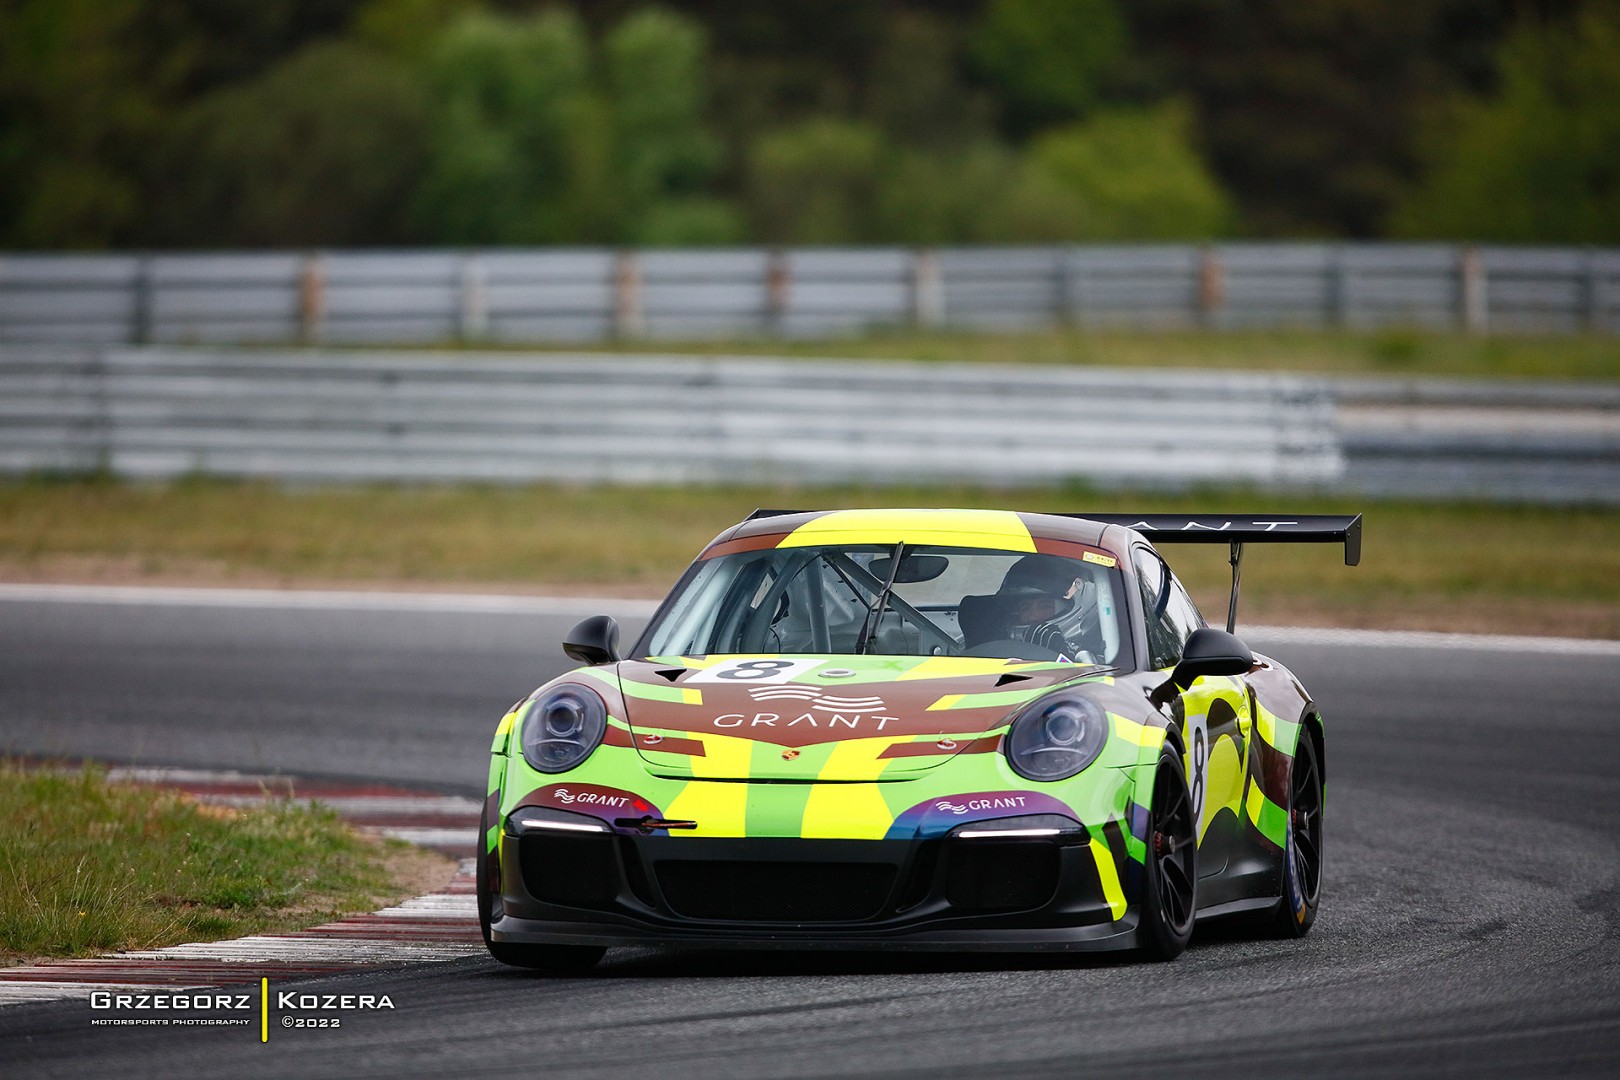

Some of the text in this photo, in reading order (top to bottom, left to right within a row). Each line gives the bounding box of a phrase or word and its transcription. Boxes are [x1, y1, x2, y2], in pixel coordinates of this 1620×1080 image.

[1127, 521, 1298, 531] ANT
[716, 660, 795, 680] 8
[713, 712, 900, 731] GRANT
[1191, 726, 1205, 826] 8
[577, 792, 630, 808] GRANT
[968, 796, 1026, 810] GRANT
